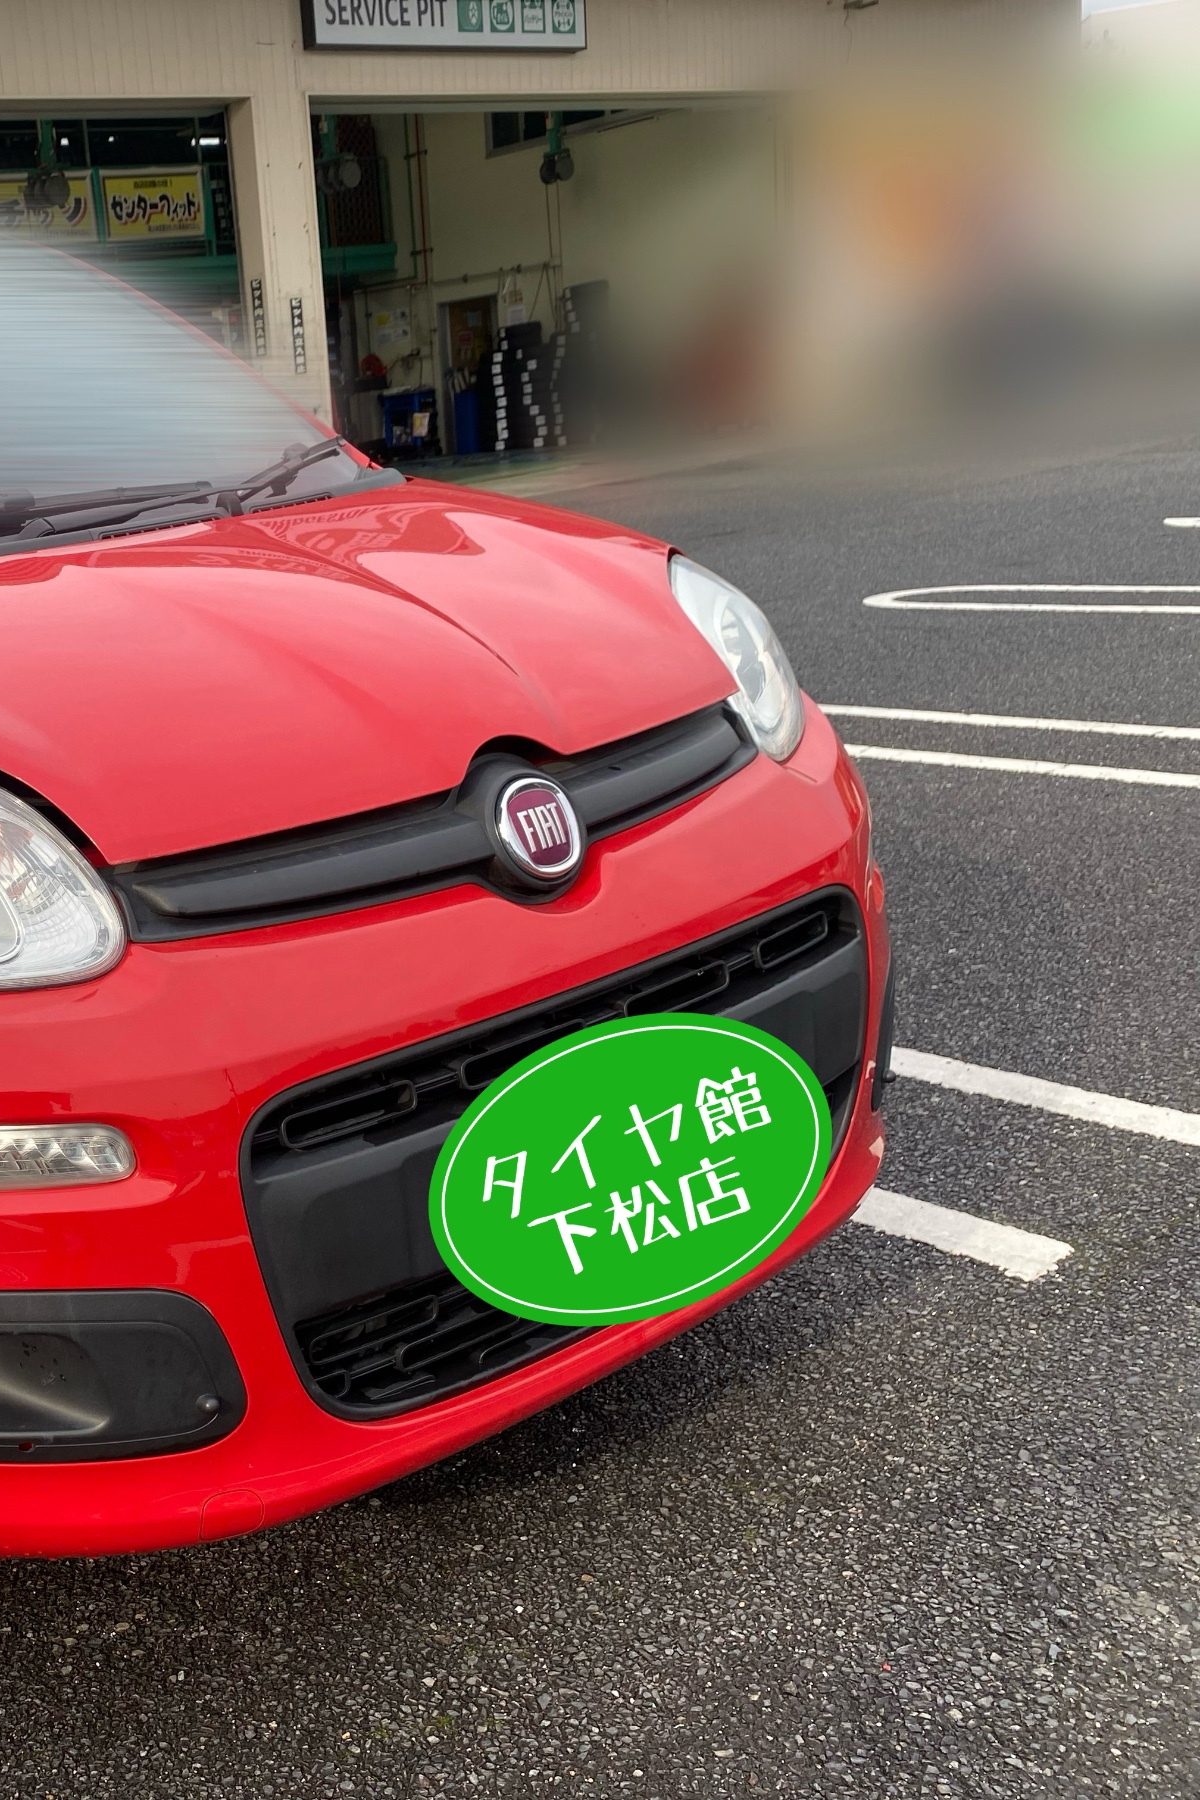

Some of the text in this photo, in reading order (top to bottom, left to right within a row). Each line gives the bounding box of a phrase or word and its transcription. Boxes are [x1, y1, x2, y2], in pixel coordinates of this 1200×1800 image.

[325, 0, 448, 28] SERVICE PIT
[516, 801, 569, 854] FIAT
